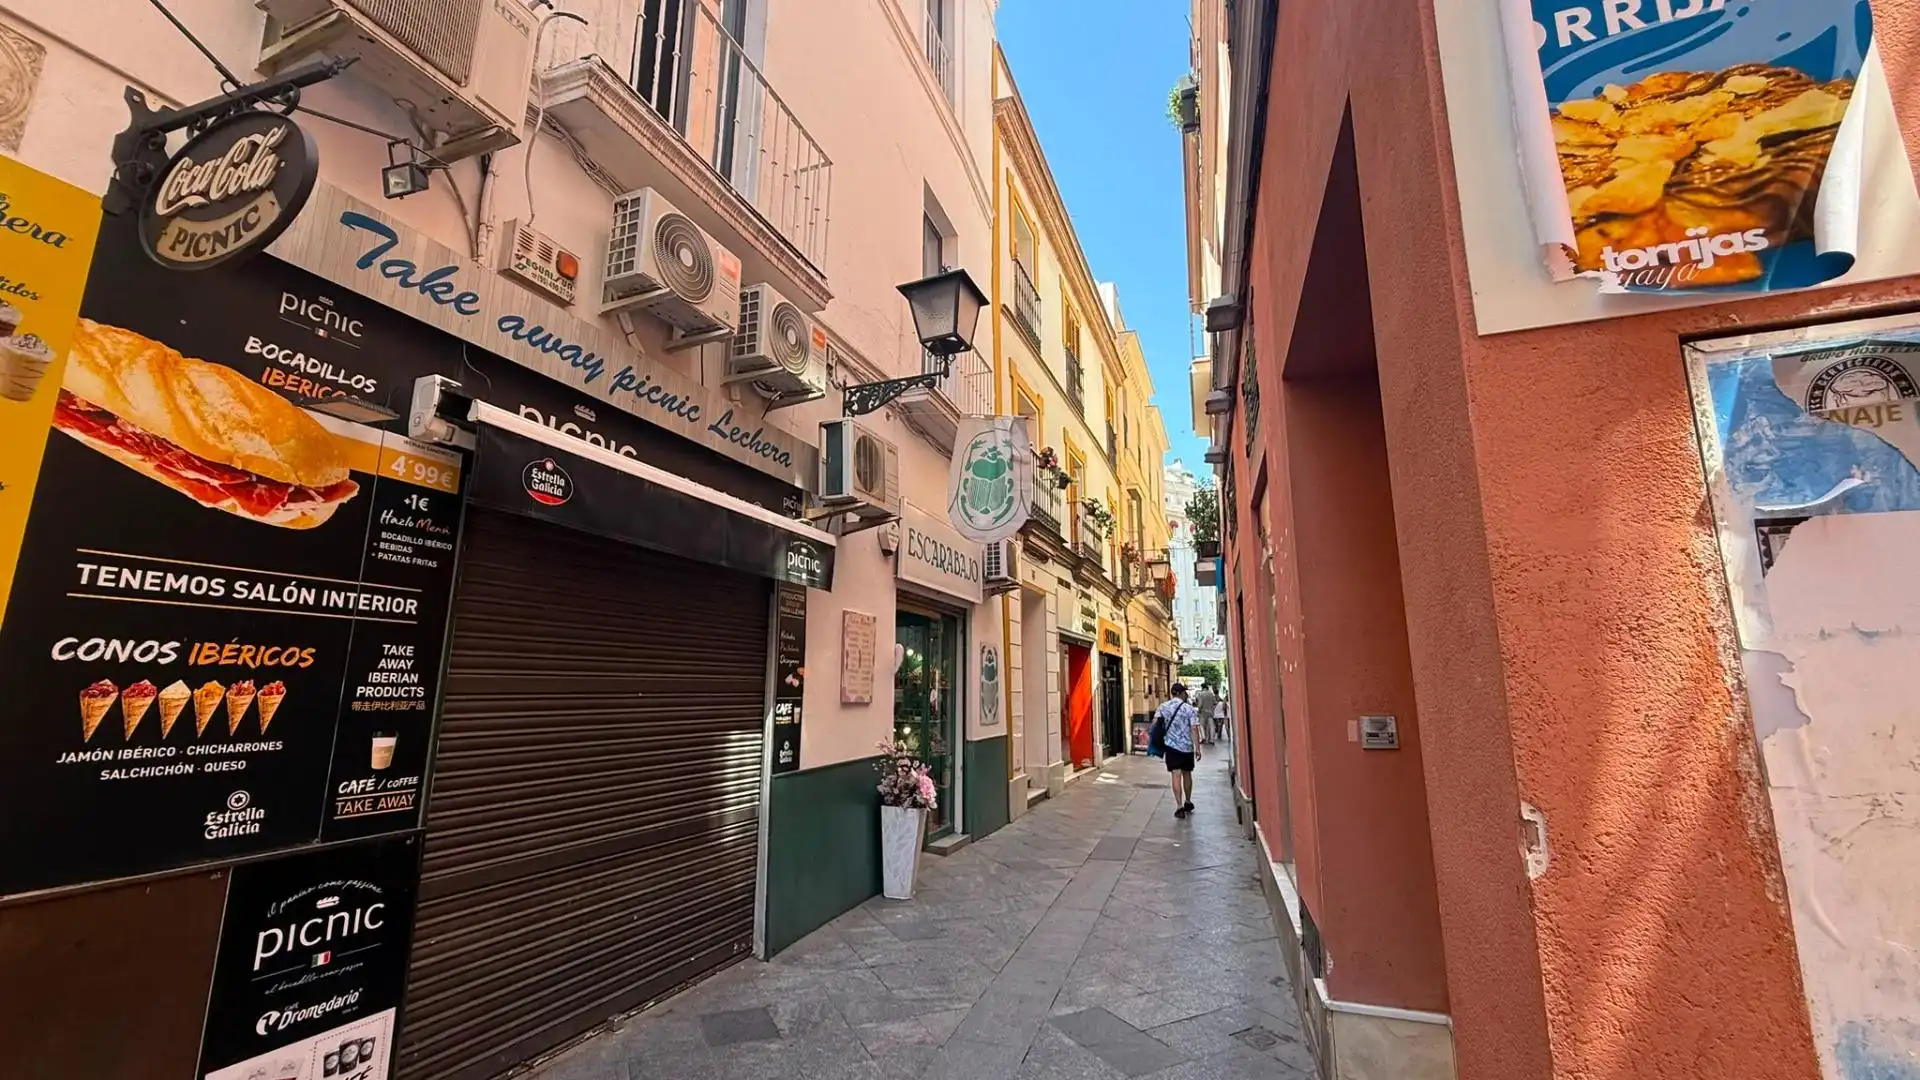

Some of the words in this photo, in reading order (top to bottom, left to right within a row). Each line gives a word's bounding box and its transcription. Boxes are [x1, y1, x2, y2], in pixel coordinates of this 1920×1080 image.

[155, 124, 288, 216] Coca-Cola
[168, 205, 261, 258] PICNIC
[1600, 227, 1769, 273] torrijas
[280, 291, 364, 338] picnic
[340, 211, 480, 316] Take
[497, 315, 604, 384] away
[609, 366, 700, 423] picnic
[708, 409, 792, 468] Lechera
[244, 335, 377, 393] BOCADILLOS
[261, 366, 360, 400] IBÉRIC
[531, 468, 565, 487] Estrella
[531, 479, 563, 496] Galicia
[380, 509, 414, 528] Hazlo
[379, 541, 413, 554] BEBIDAS
[381, 531, 423, 546] BOCADILLO
[424, 539, 452, 551] IBÉRICO
[377, 552, 411, 564] PATATAS
[412, 557, 437, 568] FRITAS
[788, 551, 821, 573] picnic
[908, 528, 979, 582] ESCARABAJO
[76, 563, 226, 597] TENEMOS
[232, 580, 316, 606] SALÓN
[321, 589, 418, 615] INTERIOR
[51, 636, 181, 665] CONOS
[188, 637, 317, 669] IBÉRICOS
[382, 644, 415, 656] TAKE
[377, 659, 414, 670] AWAY
[368, 672, 419, 683] IBERIAN
[356, 686, 425, 698] PRODUCTS
[56, 747, 114, 764] JAMÓN
[117, 745, 176, 761] IBÉRICO
[186, 741, 283, 756] CHICHARRONES
[100, 761, 194, 781] SALCHICHÓN
[204, 760, 247, 773] QUESO
[338, 775, 376, 795] CAFÉ
[387, 776, 419, 788] COFFEE
[335, 797, 375, 815] TAKE
[376, 794, 416, 811] AWAY
[204, 806, 265, 826] Estrella
[204, 821, 260, 840] Galicia
[253, 903, 385, 972] picnic
[278, 989, 361, 1031] Dromedario
